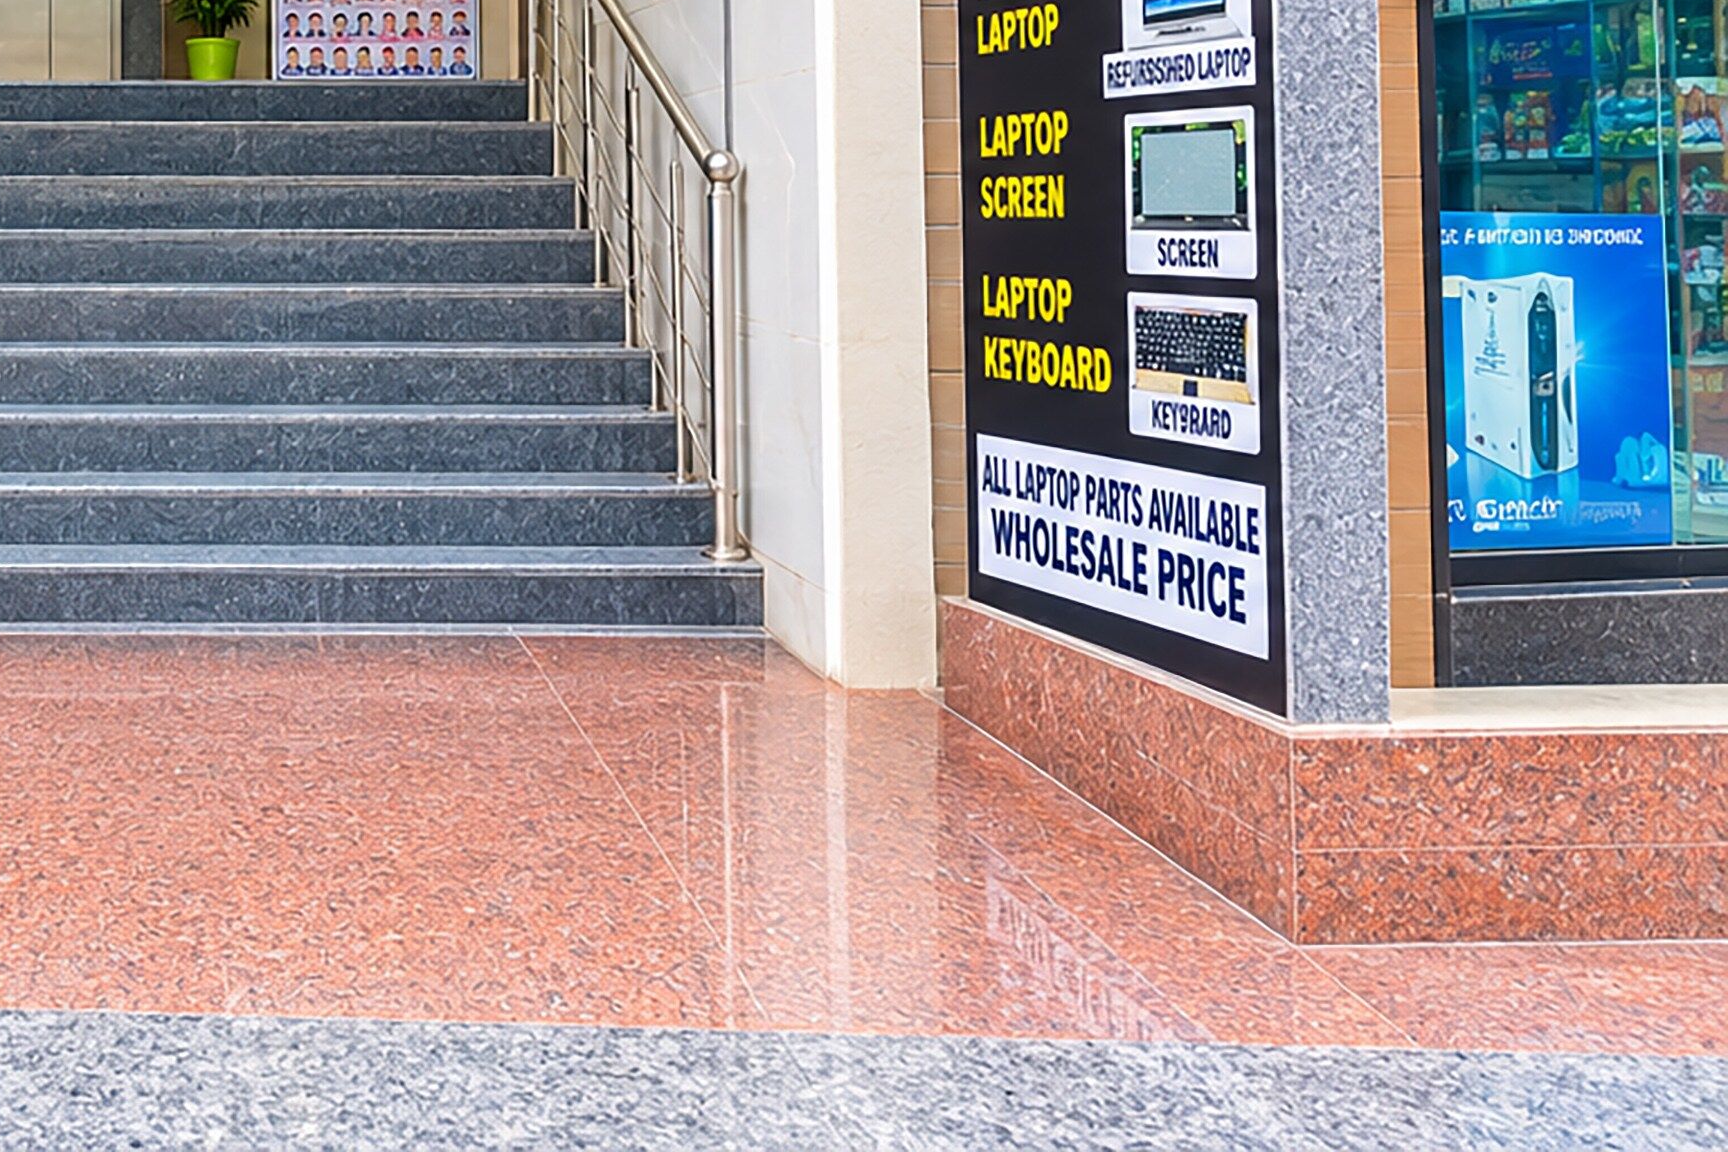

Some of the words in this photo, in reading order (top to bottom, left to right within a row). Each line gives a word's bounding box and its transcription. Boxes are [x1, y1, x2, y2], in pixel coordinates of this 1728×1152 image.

[977, 4, 1059, 55] LAPTOP
[980, 110, 1069, 157] LAPTOP
[981, 175, 1064, 219] SCREEN
[1157, 238, 1219, 269] SCREEN
[983, 275, 1073, 323] LAPTOP
[983, 336, 1112, 394] KEYBOARD
[982, 454, 1011, 495] ALL
[1015, 459, 1079, 512] LAPTOP
[1085, 476, 1143, 528] PARTS
[1148, 487, 1260, 555] AVAILABLE
[990, 508, 1149, 597] WHOLESALE
[1157, 547, 1247, 624] PRICE
